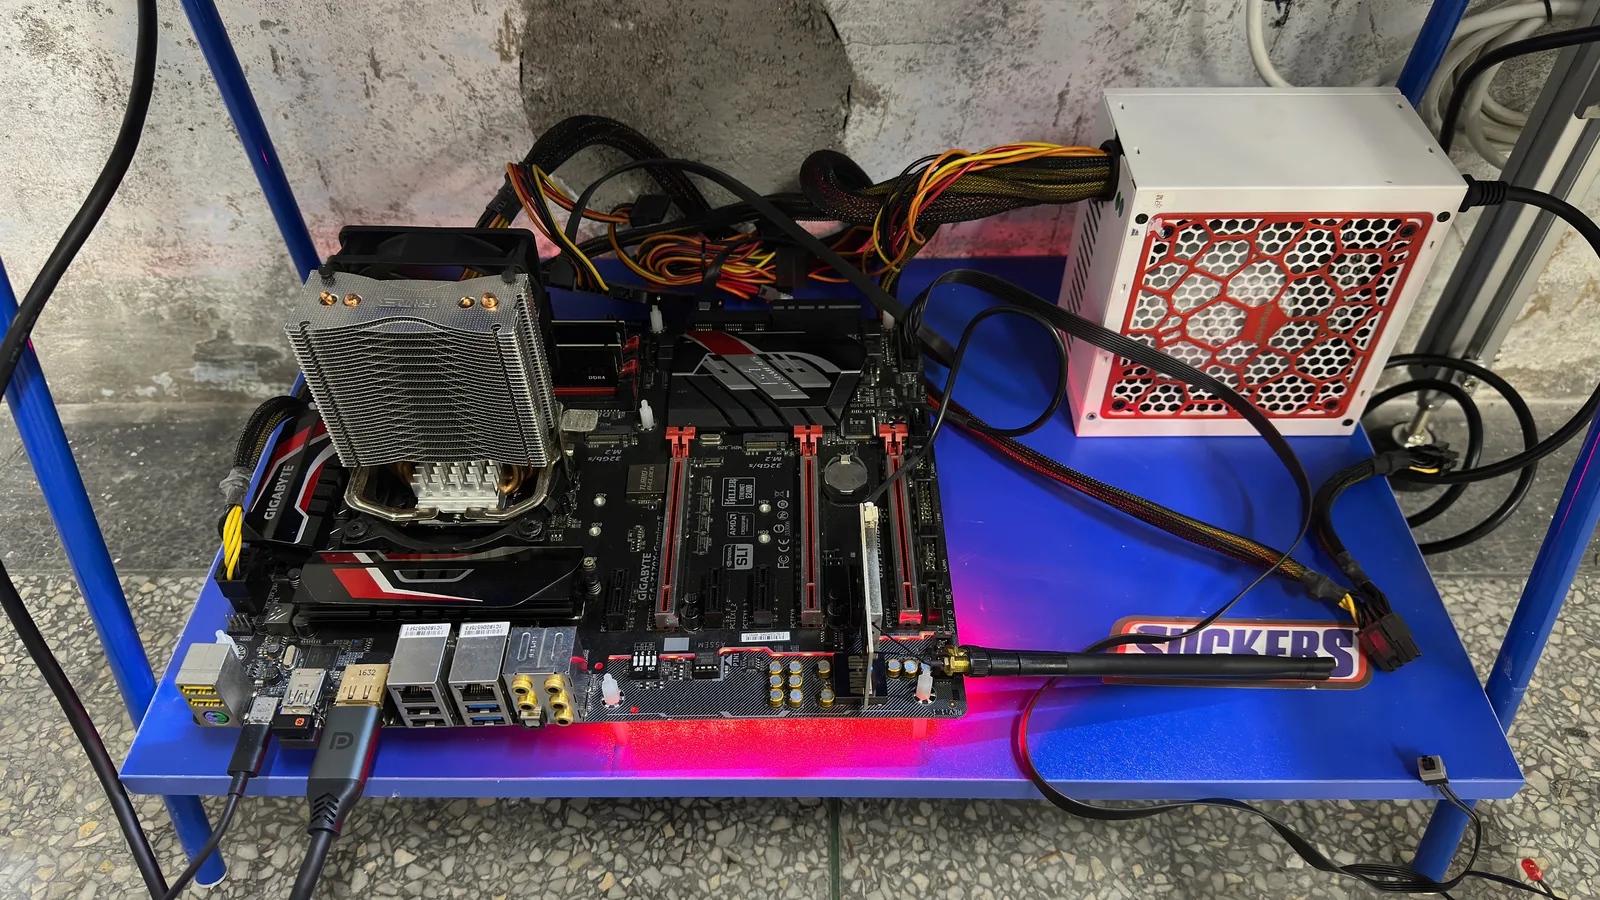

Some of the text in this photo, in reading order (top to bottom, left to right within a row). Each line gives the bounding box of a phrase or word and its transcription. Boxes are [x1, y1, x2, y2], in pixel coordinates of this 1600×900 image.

[264, 465, 294, 520] GIGABYTE
[638, 552, 652, 601] GIGABYTE
[736, 548, 748, 566] SLI
